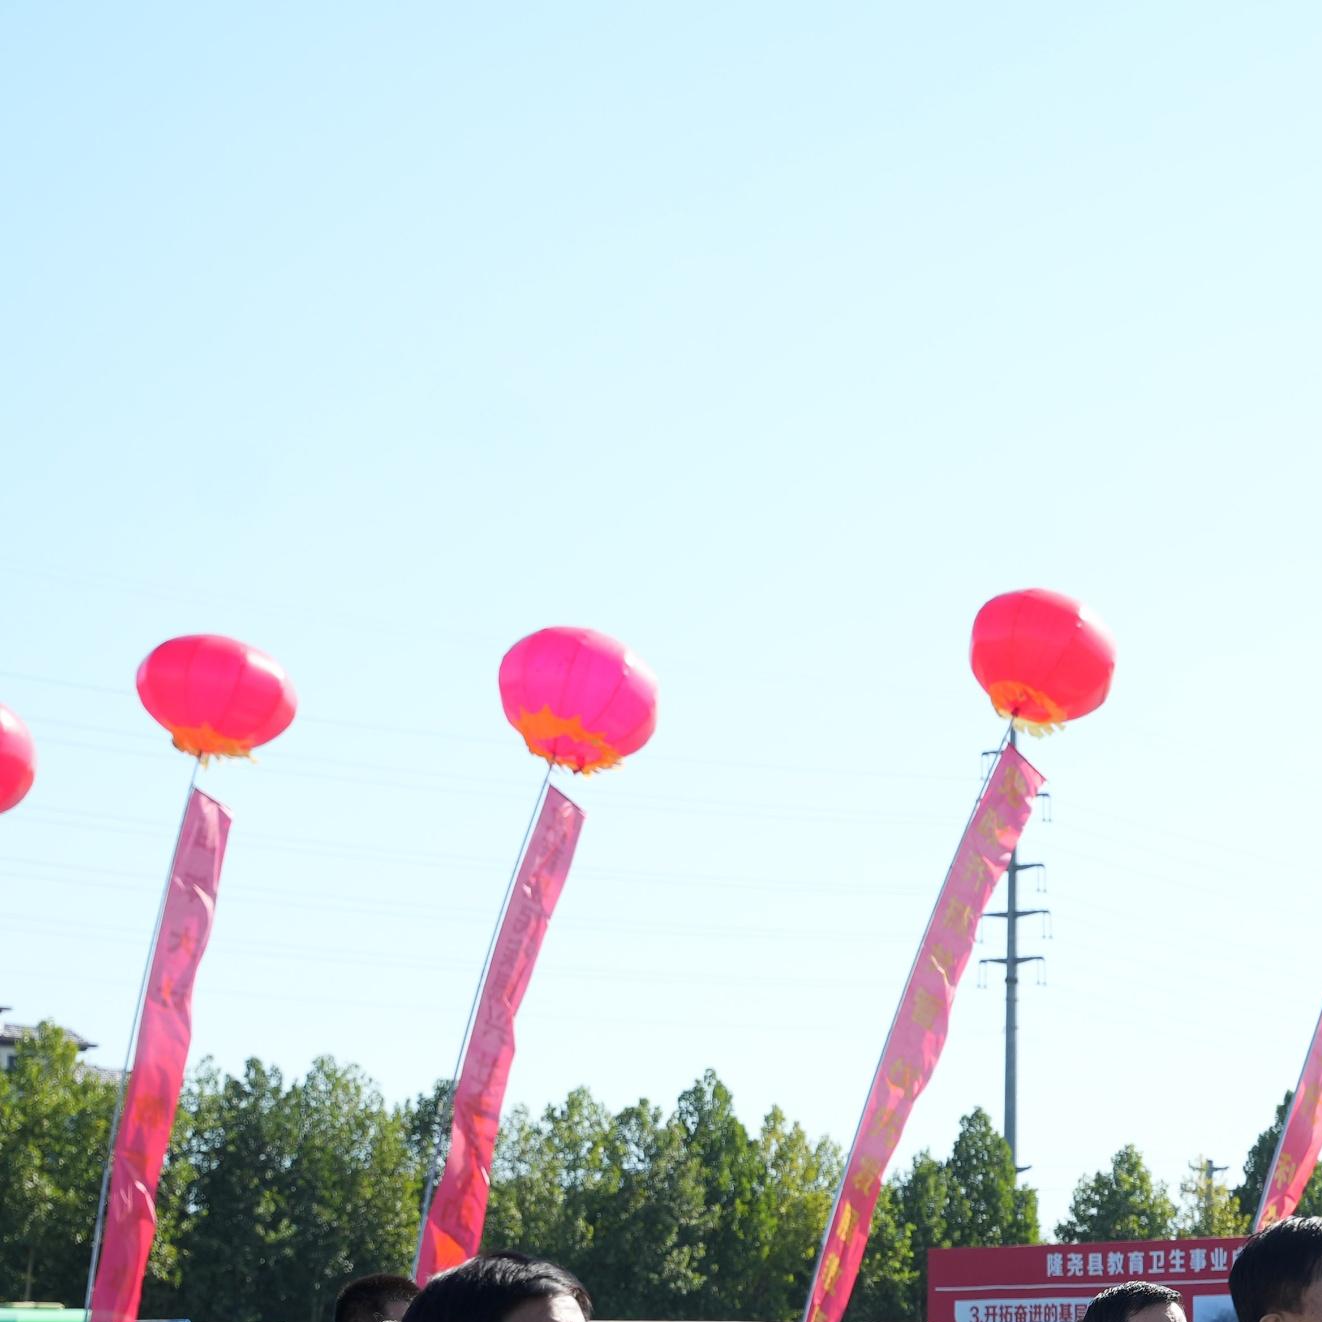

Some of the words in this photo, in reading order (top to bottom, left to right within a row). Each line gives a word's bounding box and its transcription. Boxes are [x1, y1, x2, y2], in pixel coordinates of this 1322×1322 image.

[1046, 1247, 1243, 1278] 隆尧县教育卫生事业
